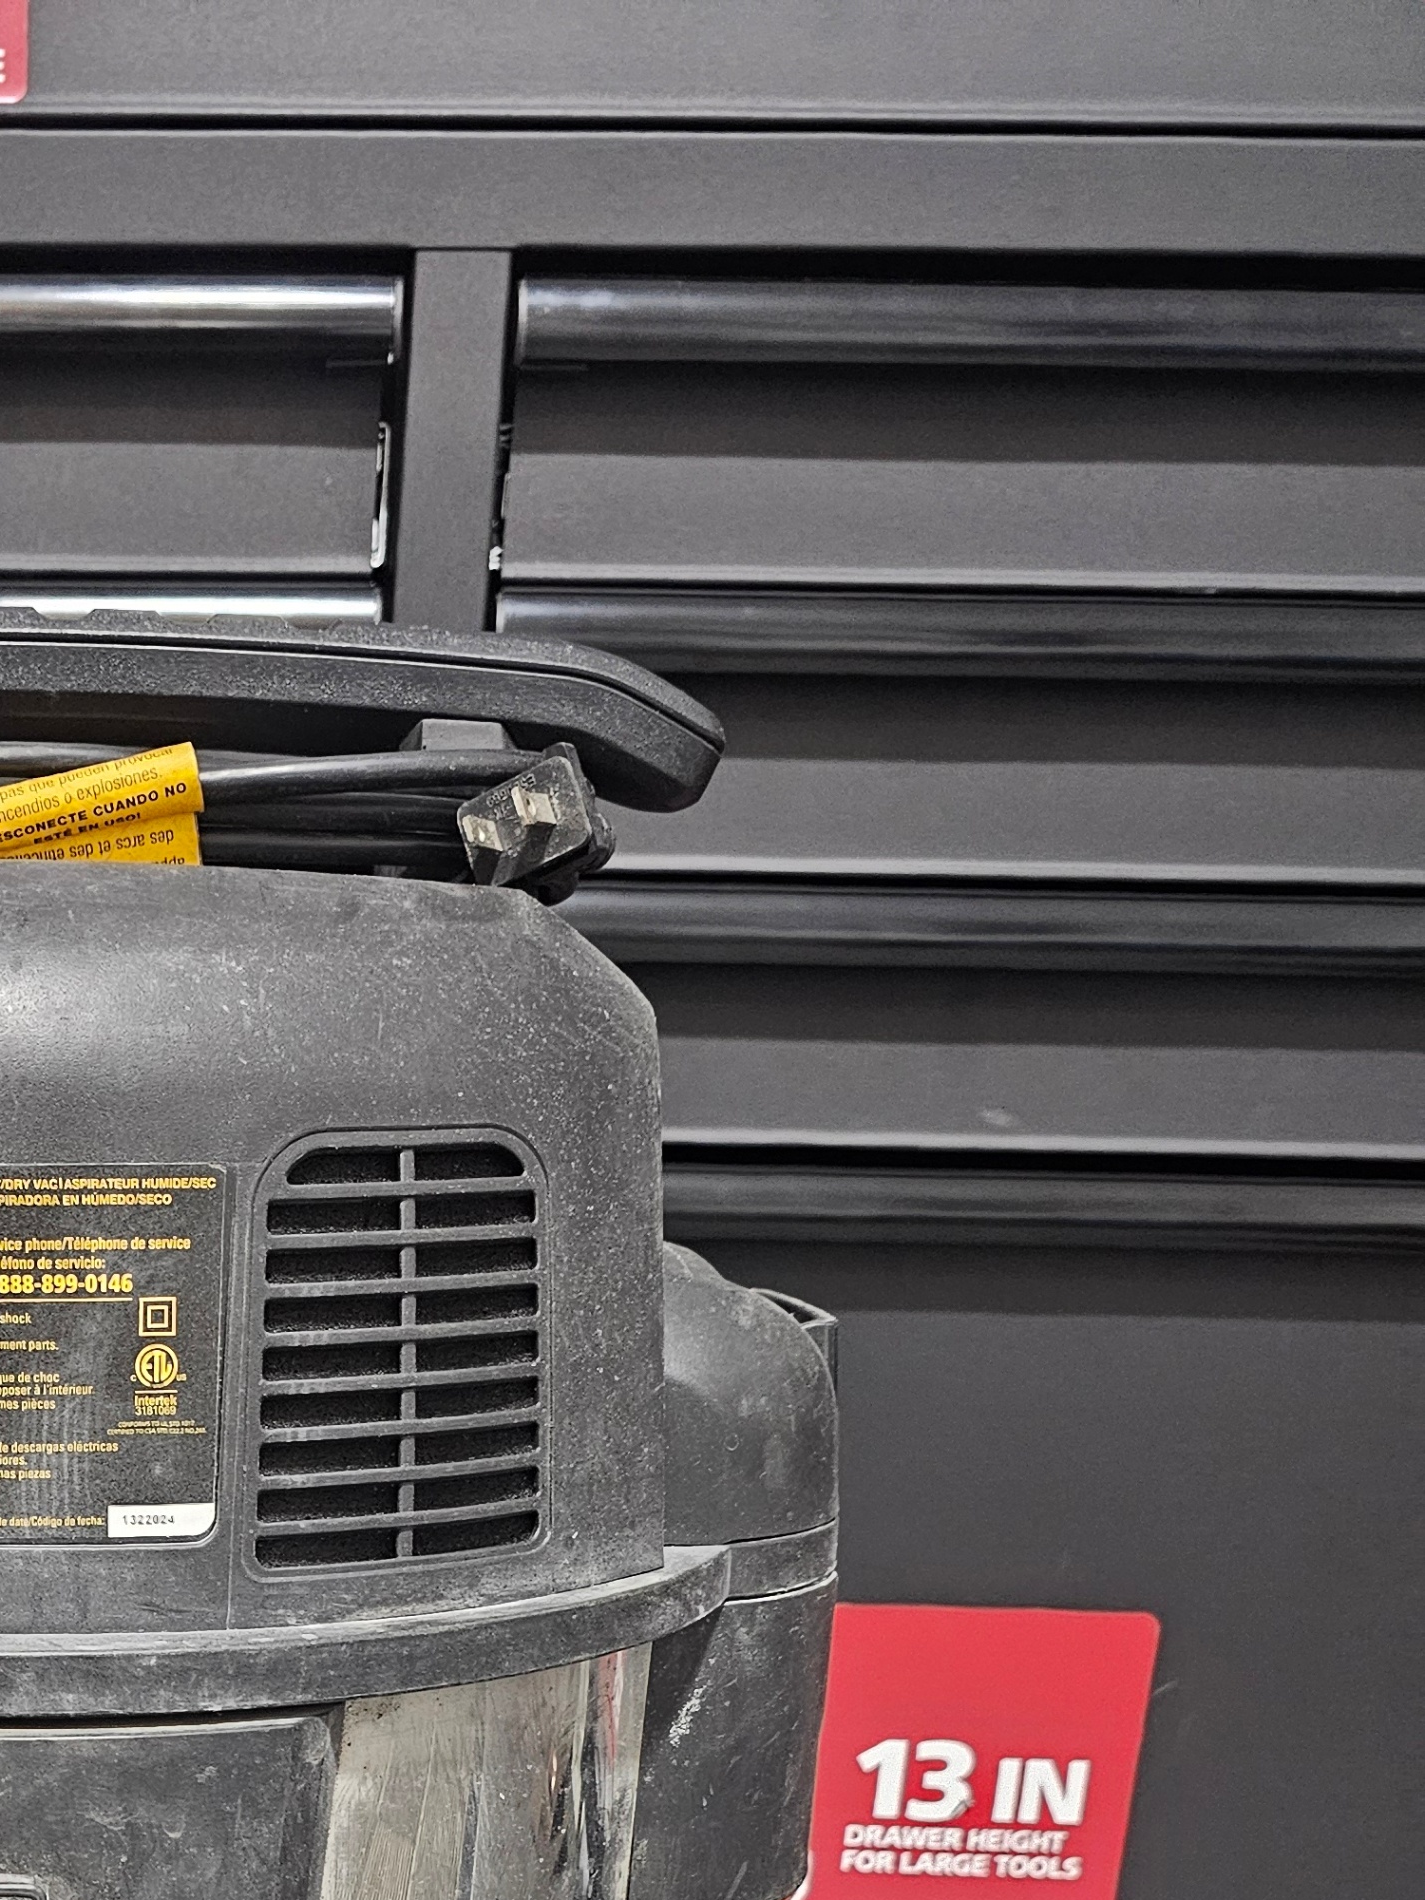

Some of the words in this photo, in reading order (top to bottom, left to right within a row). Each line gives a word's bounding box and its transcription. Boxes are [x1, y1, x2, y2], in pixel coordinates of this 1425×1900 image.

[64, 791, 72, 805] o
[77, 766, 164, 802] explosiones.
[92, 790, 159, 817] CUANDO
[164, 782, 188, 798] NO
[78, 822, 100, 834] EN
[116, 833, 146, 850] arcs
[150, 828, 175, 844] des
[69, 842, 94, 858] des
[99, 839, 111, 851] et
[141, 1177, 218, 1190] HUMIDE/SEC
[63, 1194, 80, 1206] EN
[81, 1191, 173, 1206] HÚMEDO/SECO
[25, 1236, 128, 1253] phone/Téléphone
[130, 1237, 146, 1250] de
[148, 1236, 191, 1250] service
[37, 1256, 52, 1270] de
[55, 1255, 106, 1270] servicio:
[0, 1312, 32, 1324] shock
[28, 1340, 59, 1353] parts.
[17, 1372, 31, 1383] de
[33, 1372, 60, 1383] choc
[21, 1398, 56, 1411] pièces
[134, 1394, 178, 1406] Intertek
[135, 1405, 177, 1416] 3181069
[11, 1442, 65, 1455] descargas
[67, 1440, 119, 1453] eléctricas
[18, 1468, 52, 1481] piezas
[64, 1516, 75, 1527] de
[77, 1515, 106, 1527] fecha:
[122, 1514, 176, 1526] 1322024
[856, 1738, 977, 1823] 13
[991, 1757, 1092, 1826] IN
[843, 1823, 965, 1850] DRAWER
[966, 1827, 1070, 1854] HEIGHT
[839, 1849, 897, 1875] FOR
[898, 1850, 992, 1878] LARGE
[993, 1854, 1084, 1881] TOOLS
